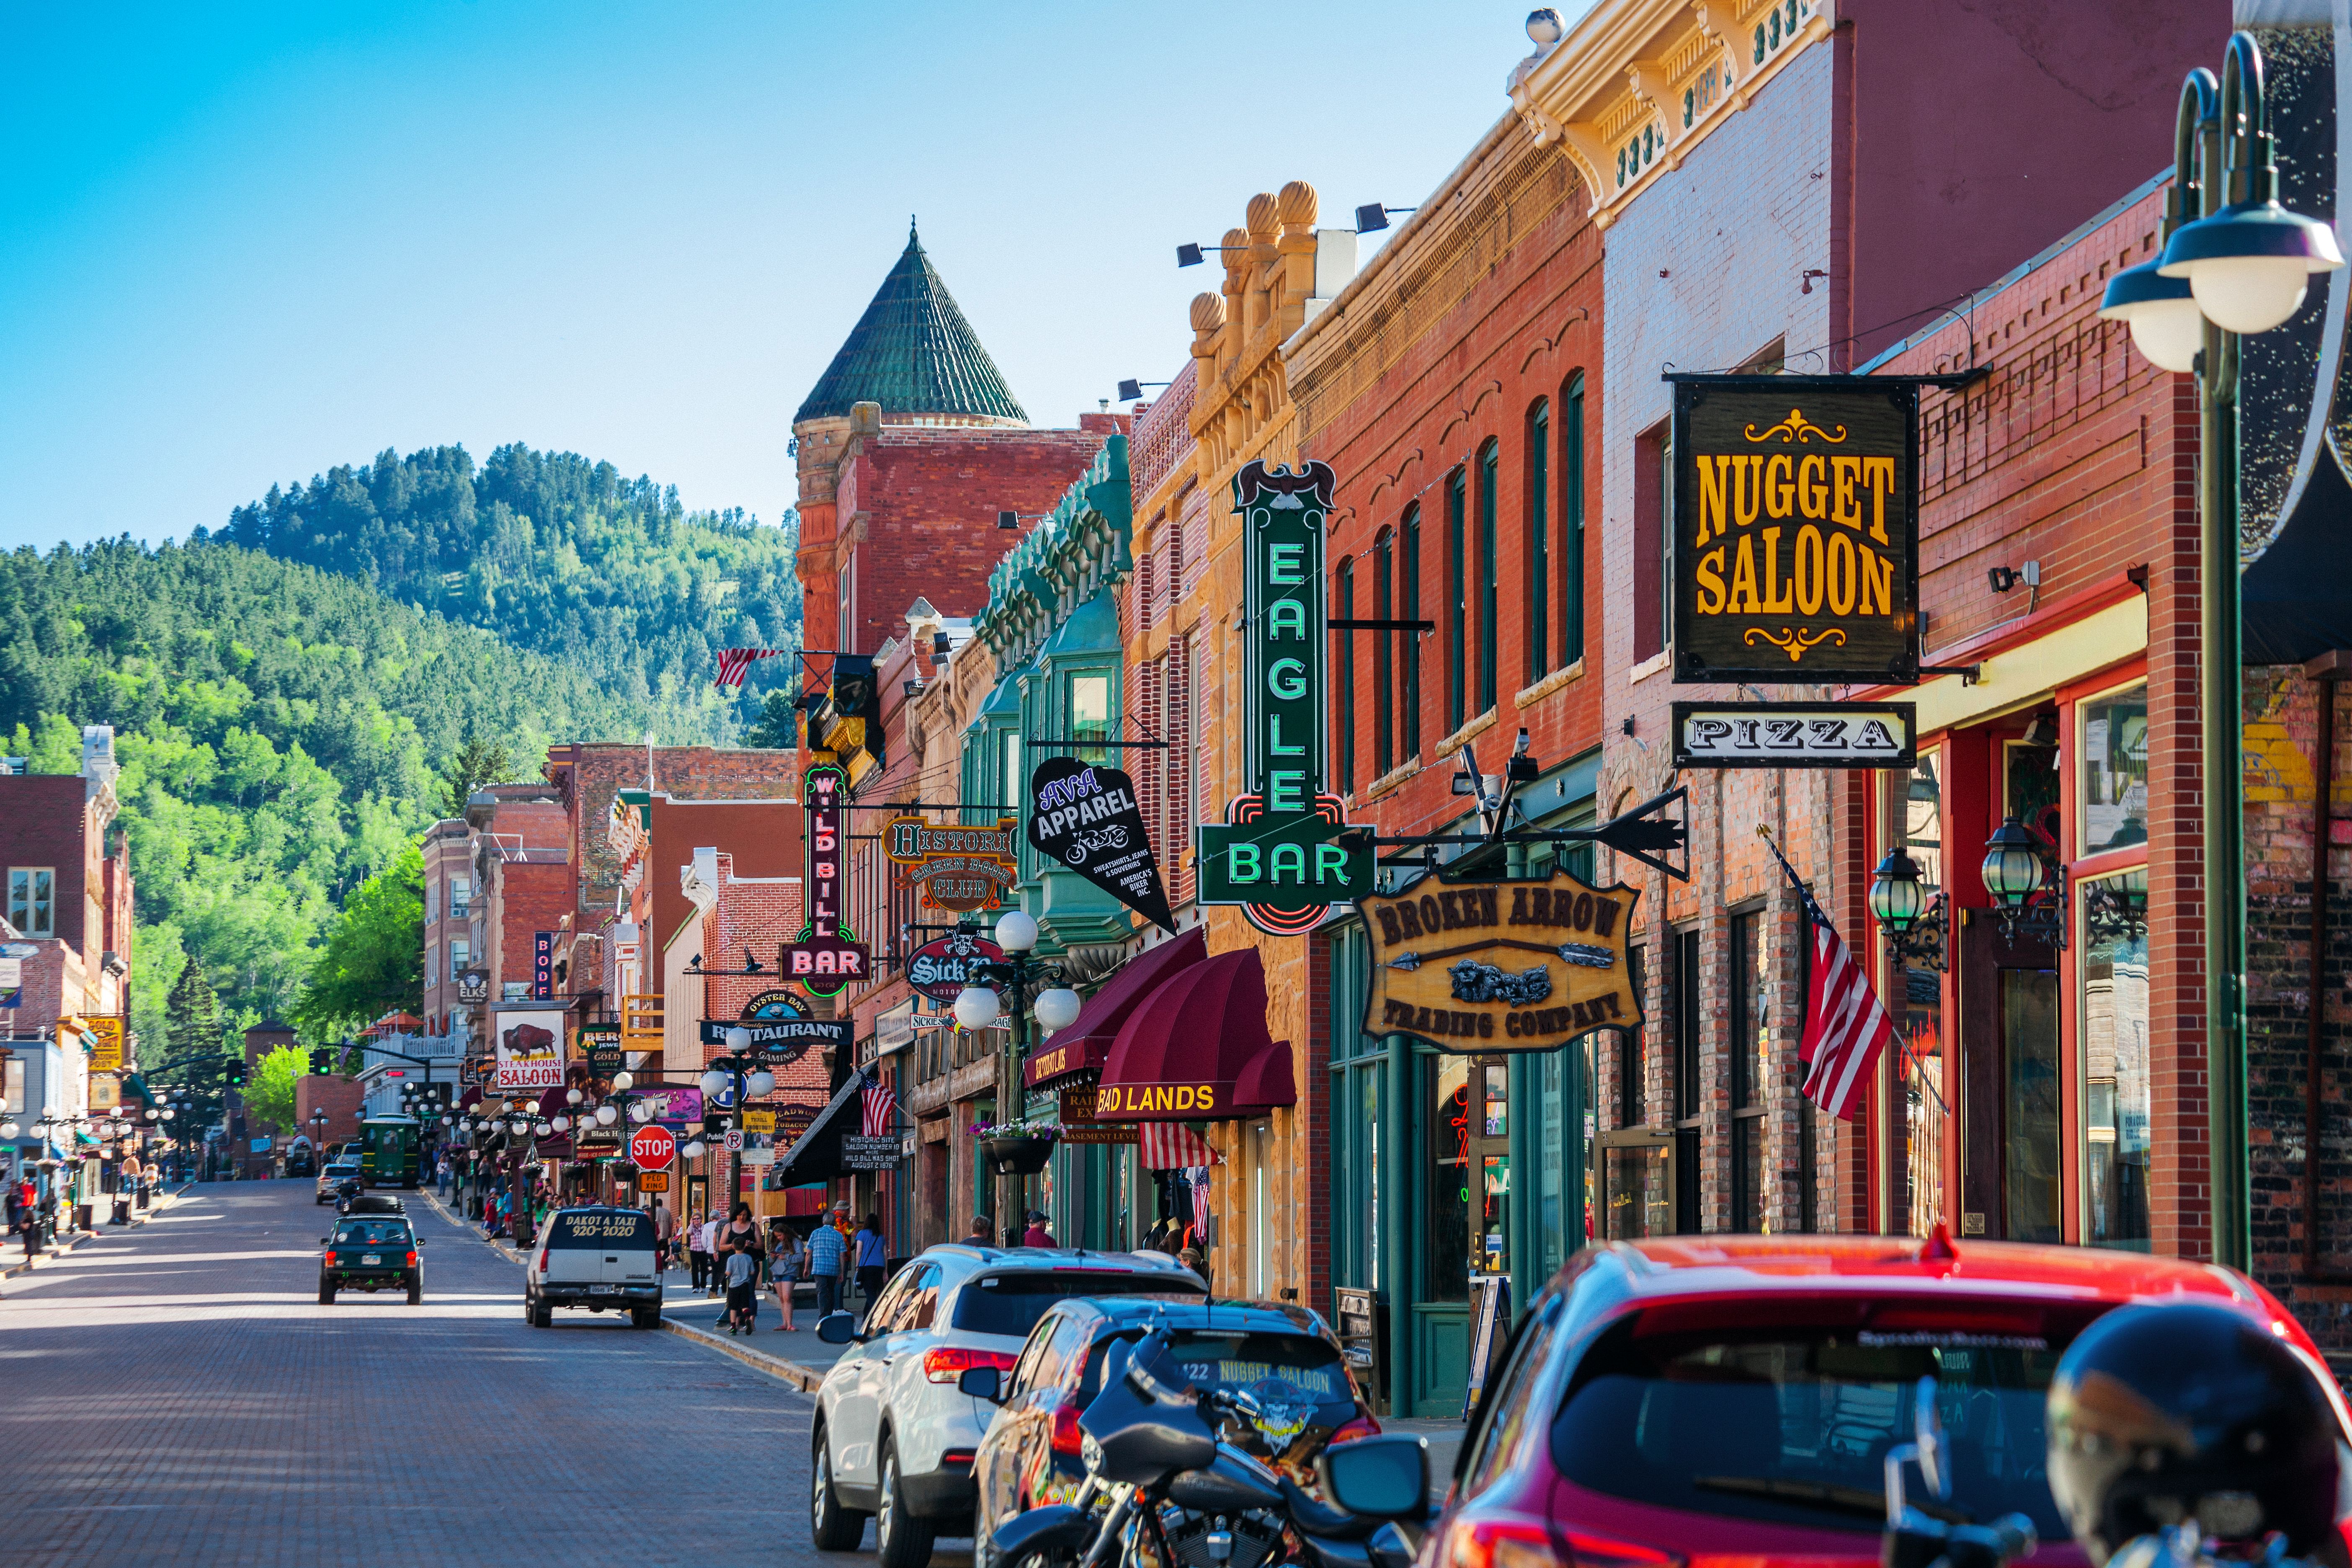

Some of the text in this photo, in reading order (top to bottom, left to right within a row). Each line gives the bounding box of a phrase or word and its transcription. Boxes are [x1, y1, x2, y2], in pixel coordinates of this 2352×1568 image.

[1696, 454, 1895, 548] NUGGET
[1696, 524, 1894, 616] SALOON
[1268, 543, 1307, 812] EAGLE
[1689, 719, 1898, 749] PIZZA
[1039, 767, 1102, 811] AVA
[815, 777, 836, 851] WILD
[1038, 788, 1135, 841] APPAREL
[911, 857, 1011, 885] GREEN DOOR
[1093, 849, 1148, 874] SWEATSHIRTS, JEANS
[1111, 860, 1140, 875] SOUVENIRS
[1229, 843, 1351, 886] BAR
[934, 879, 986, 898] CLUB
[1120, 868, 1152, 887] AMERICA'S
[1130, 880, 1148, 892] BIKER
[816, 862, 835, 936] BILL
[1137, 888, 1150, 897] INC.
[1375, 887, 1621, 946] BROKEN ARROW
[792, 950, 861, 974] BAR
[910, 954, 966, 985] Sick
[460, 988, 487, 998] ELKS
[750, 993, 807, 1012] OYSTER BAY
[88, 1021, 114, 1031] GOLD
[913, 1015, 943, 1027] SICKIES
[1383, 992, 1624, 1038] TRADING COMPANY
[712, 1023, 843, 1042] RTAURANT
[498, 1060, 562, 1068] STEAKHOUSE
[759, 1050, 797, 1062] GAMING
[500, 1069, 562, 1086] SALOON
[1096, 1085, 1214, 1113] BAD LANDS
[634, 1140, 673, 1156] STOP
[614, 1216, 637, 1226] TAXI
[1219, 1360, 1272, 1382] NUGGET
[1278, 1364, 1331, 1394] SALOON
